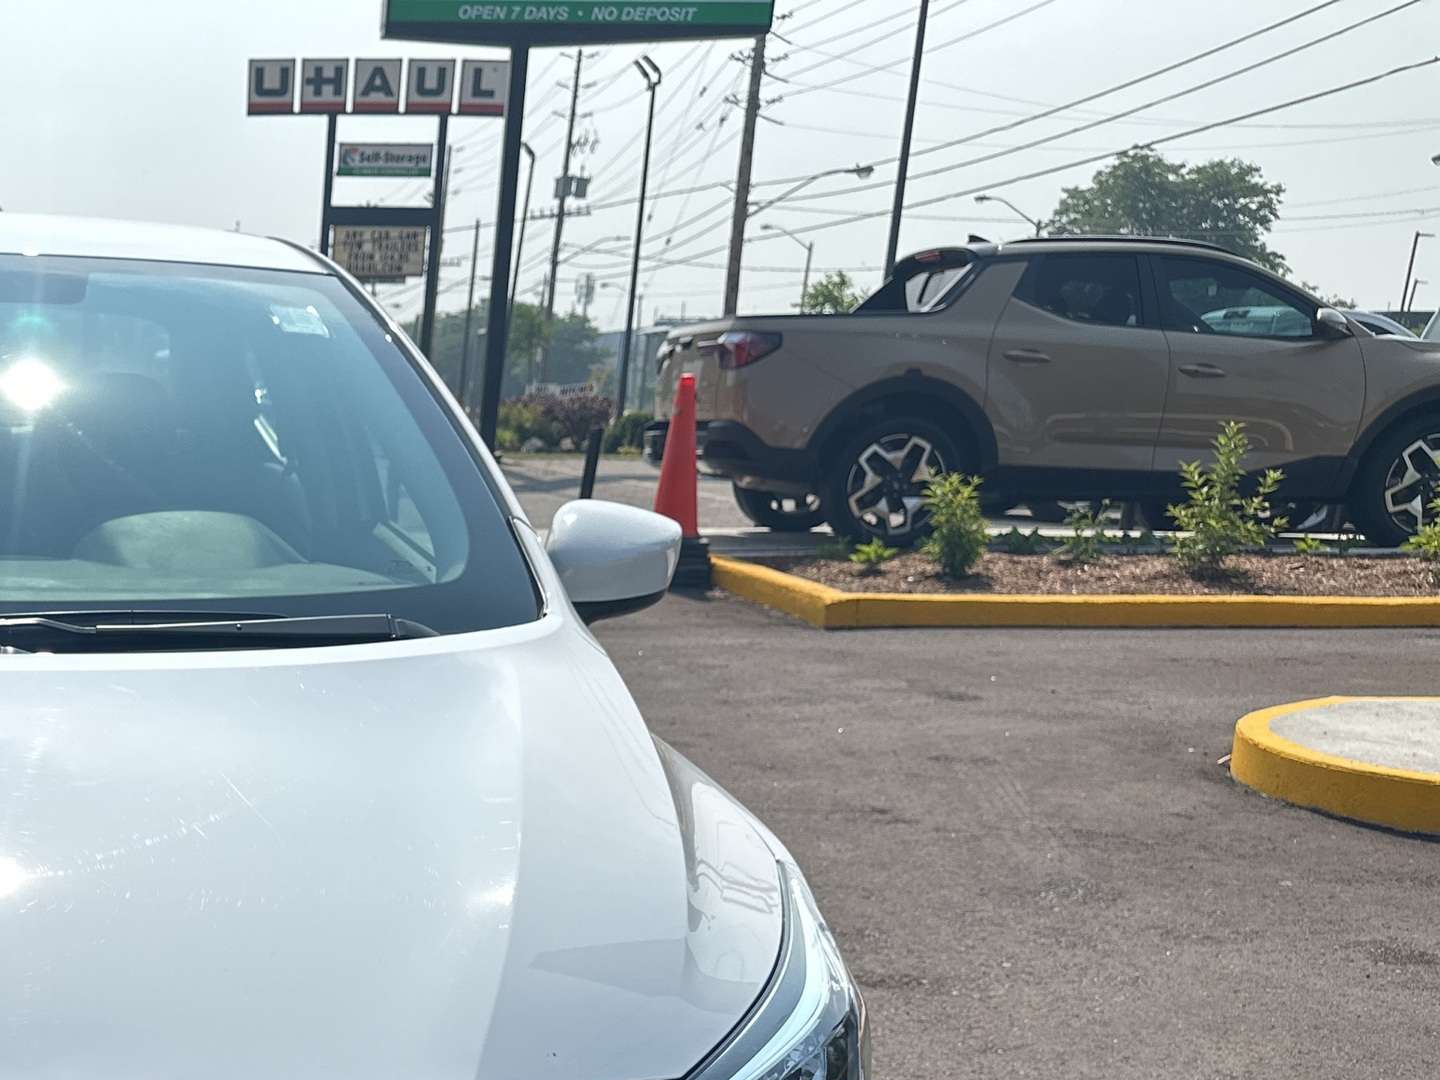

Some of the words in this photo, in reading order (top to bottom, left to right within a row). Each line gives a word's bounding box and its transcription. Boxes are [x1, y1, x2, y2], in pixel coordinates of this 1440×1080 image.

[458, 5, 507, 20] OPEN
[510, 6, 521, 19] 7
[524, 6, 569, 20] DAYS
[591, 6, 617, 20] NO
[621, 7, 698, 21] DEPOSIT
